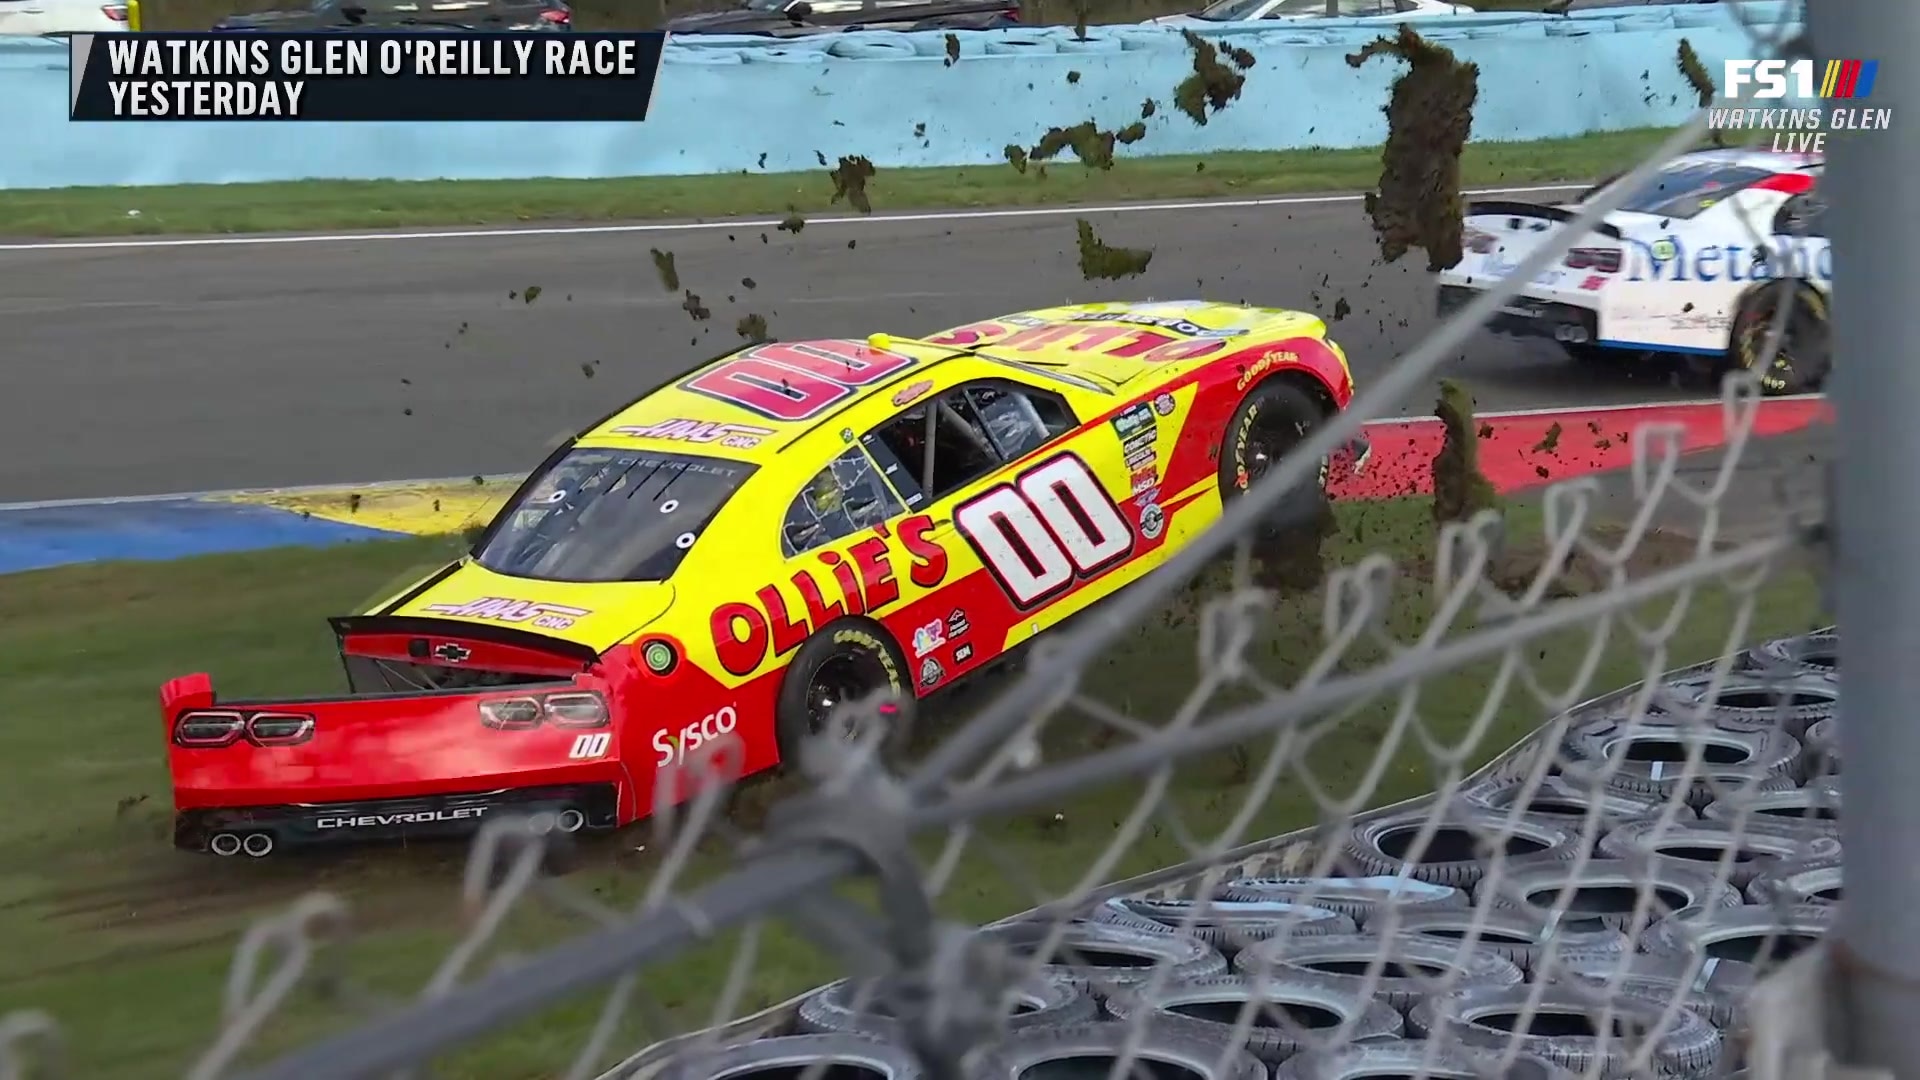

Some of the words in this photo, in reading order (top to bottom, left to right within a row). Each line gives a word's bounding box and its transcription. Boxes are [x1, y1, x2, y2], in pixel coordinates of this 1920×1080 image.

[679, 339, 917, 421] 00
[1236, 350, 1299, 391] GOODYEAR
[611, 418, 777, 443] HAAS
[1234, 403, 1259, 497] ODYEAR
[617, 457, 738, 478] CHEVROLET
[953, 450, 1135, 611] 00
[422, 597, 592, 623] HAAS
[569, 732, 611, 759] 00
[317, 806, 489, 830] CHEVROLET
